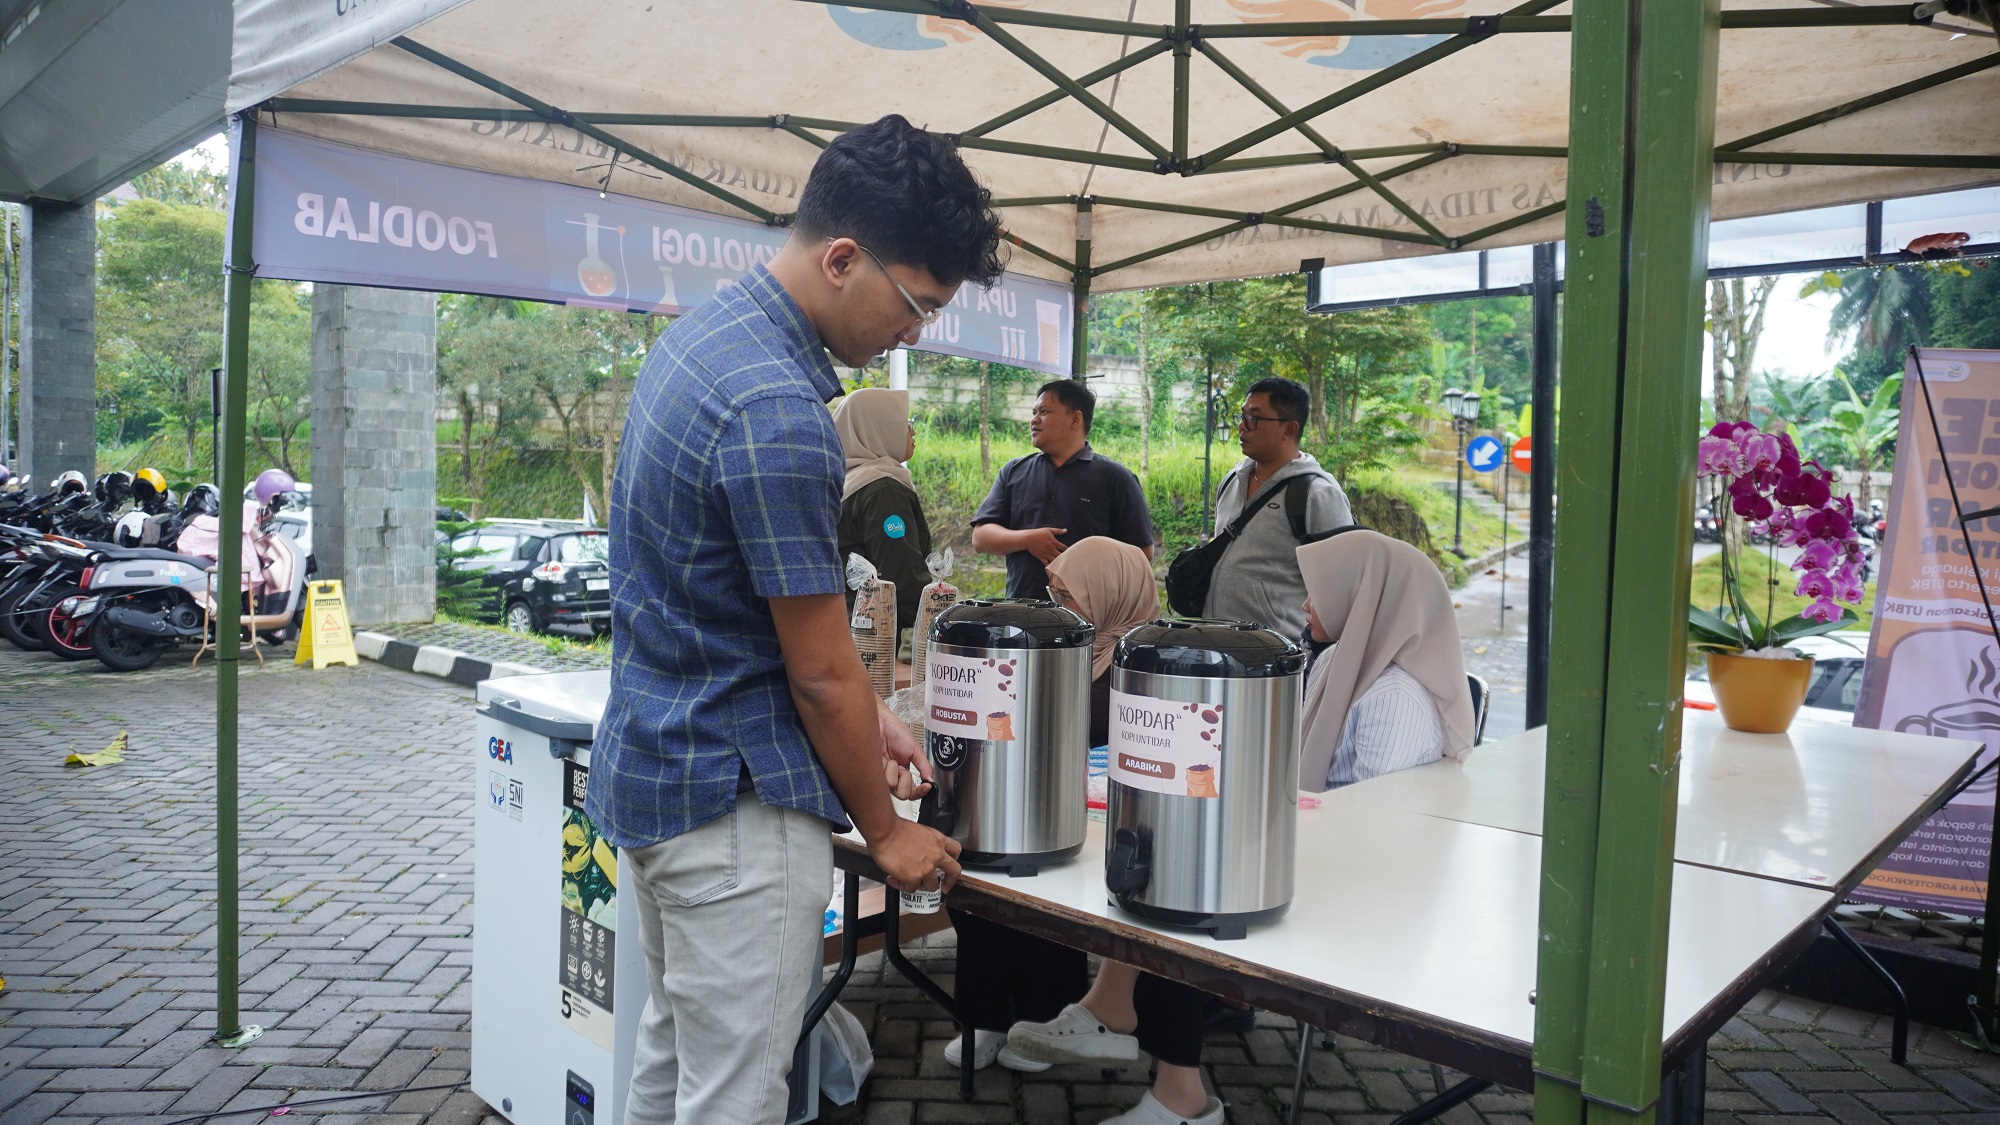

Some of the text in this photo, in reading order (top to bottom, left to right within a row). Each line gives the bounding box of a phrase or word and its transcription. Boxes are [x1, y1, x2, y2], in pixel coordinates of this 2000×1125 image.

[945, 688, 973, 699] UNTIDAR
[936, 709, 967, 721] ROBUSTA
[1121, 730, 1171, 748] KOPI UNTIDAR
[489, 736, 513, 765] GEA
[1125, 758, 1162, 773] ARABIKA
[509, 783, 523, 805] SNI
[561, 989, 572, 1019] 5
